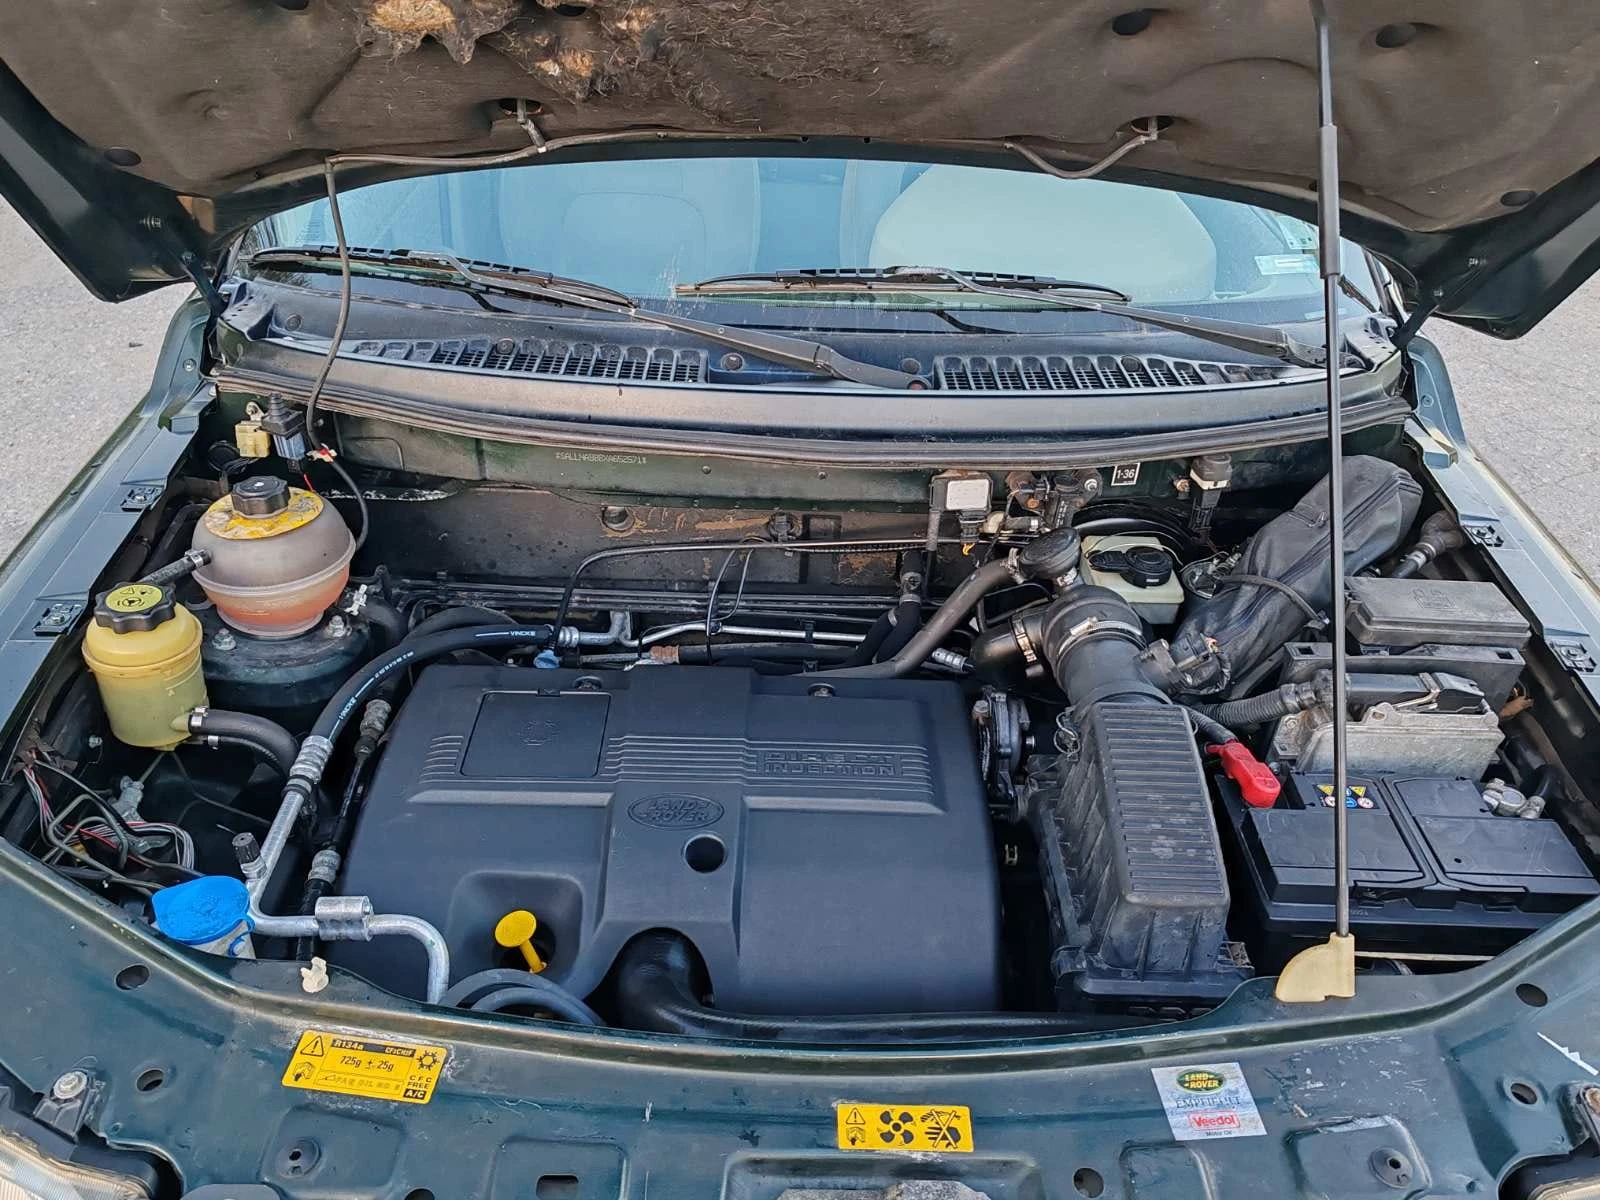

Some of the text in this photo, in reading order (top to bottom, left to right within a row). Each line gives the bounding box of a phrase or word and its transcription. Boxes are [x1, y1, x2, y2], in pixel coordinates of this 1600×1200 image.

[766, 764, 895, 776] INJECTION
[334, 1040, 364, 1050] R134a
[340, 1055, 361, 1068] 725g
[376, 1060, 394, 1071] 25g
[1184, 1073, 1208, 1081] LAND
[406, 1081, 430, 1090] FREE
[1189, 1079, 1219, 1089] ROVER
[405, 1089, 425, 1099] A/C
[1193, 1115, 1235, 1127] Veedol
